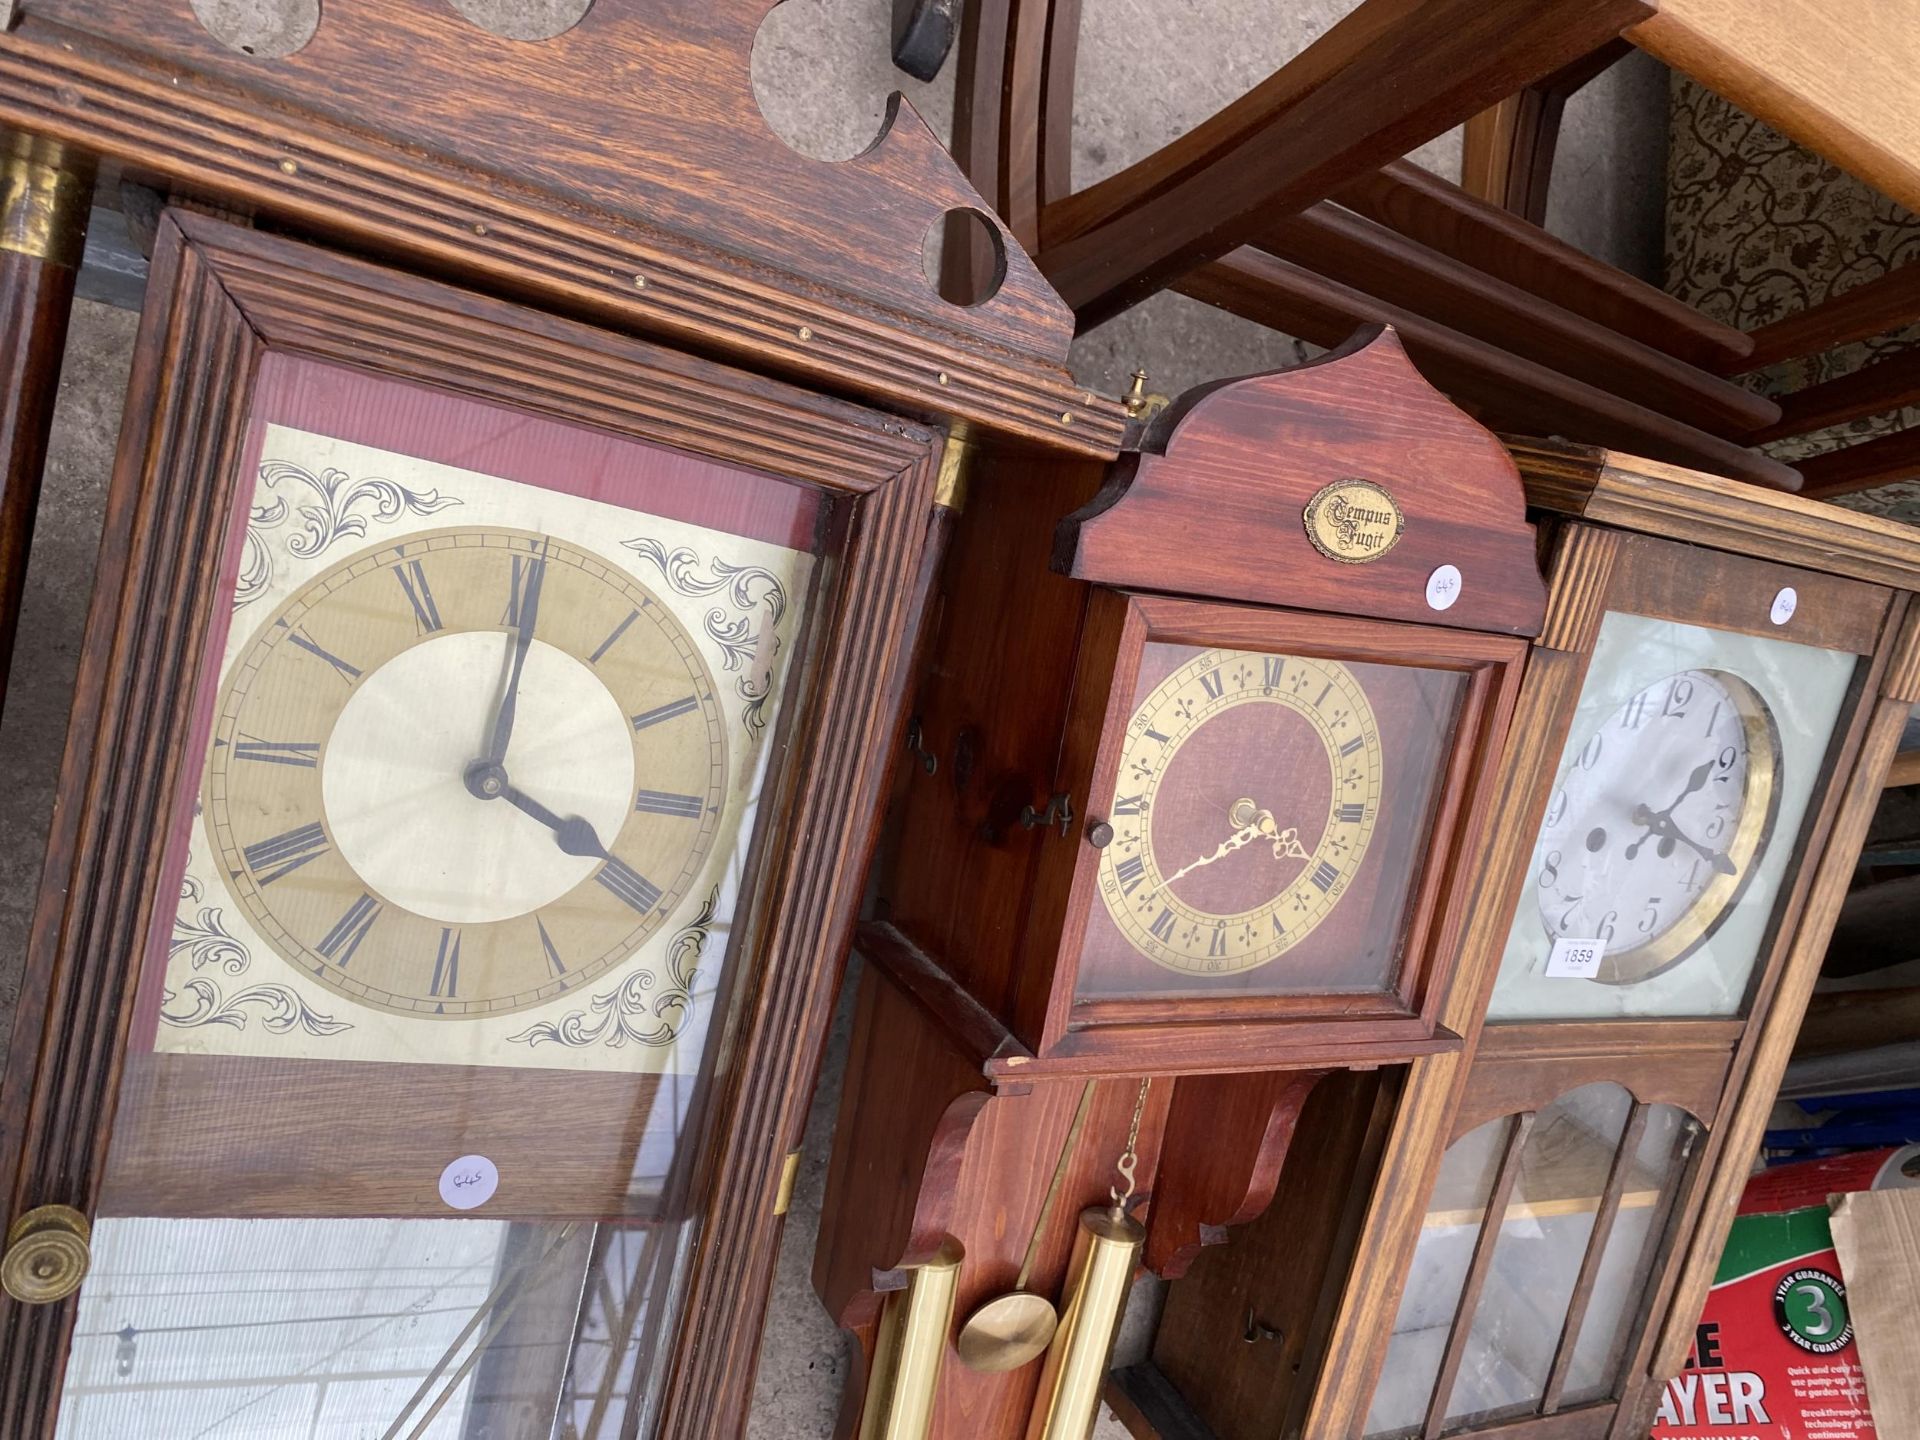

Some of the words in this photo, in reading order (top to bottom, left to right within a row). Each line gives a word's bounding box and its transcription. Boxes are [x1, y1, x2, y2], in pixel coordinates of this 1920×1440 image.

[1324, 495, 1391, 527] Tempus
[1336, 520, 1384, 551] Fugit
[392, 559, 446, 637] XI
[585, 609, 641, 665] I
[288, 624, 364, 686] X
[1258, 656, 1286, 688] XII
[1197, 669, 1225, 704] XI
[1313, 681, 1334, 709] I
[1662, 679, 1694, 718] 12
[630, 694, 701, 734] II
[1621, 692, 1647, 729] 11
[1705, 701, 1721, 738] 1
[234, 731, 320, 768] IX
[1143, 722, 1172, 751] X
[1340, 733, 1365, 758] II
[1713, 746, 1737, 783] 2
[635, 789, 704, 819] III
[1113, 792, 1144, 816] IX
[1340, 804, 1365, 823] III
[242, 818, 331, 889] VIII
[1539, 850, 1562, 888] 8
[592, 856, 664, 916] IIII
[1114, 853, 1147, 898] VIII
[1310, 860, 1340, 894] IIII
[1678, 859, 1698, 892] 4
[1148, 905, 1178, 944] VII
[1272, 912, 1286, 940] V
[1560, 895, 1583, 931] 7
[1638, 897, 1661, 933] 5
[314, 892, 384, 969] VII
[535, 913, 566, 979] V
[1207, 928, 1227, 956] VI
[429, 927, 462, 998] VI
[1565, 949, 1593, 962] 1859
[1778, 1275, 1796, 1295] YEAR
[1796, 1285, 1832, 1336] 3
[1789, 1330, 1811, 1350] YEAR
[1788, 1366, 1810, 1376] Quick
[1812, 1365, 1829, 1374] and
[1807, 1378, 1846, 1387] pump-up
[1795, 1388, 1806, 1397] for
[1808, 1387, 1839, 1398] garden
[1801, 1408, 1861, 1418] Breakthrough
[1805, 1419, 1852, 1429] technology
